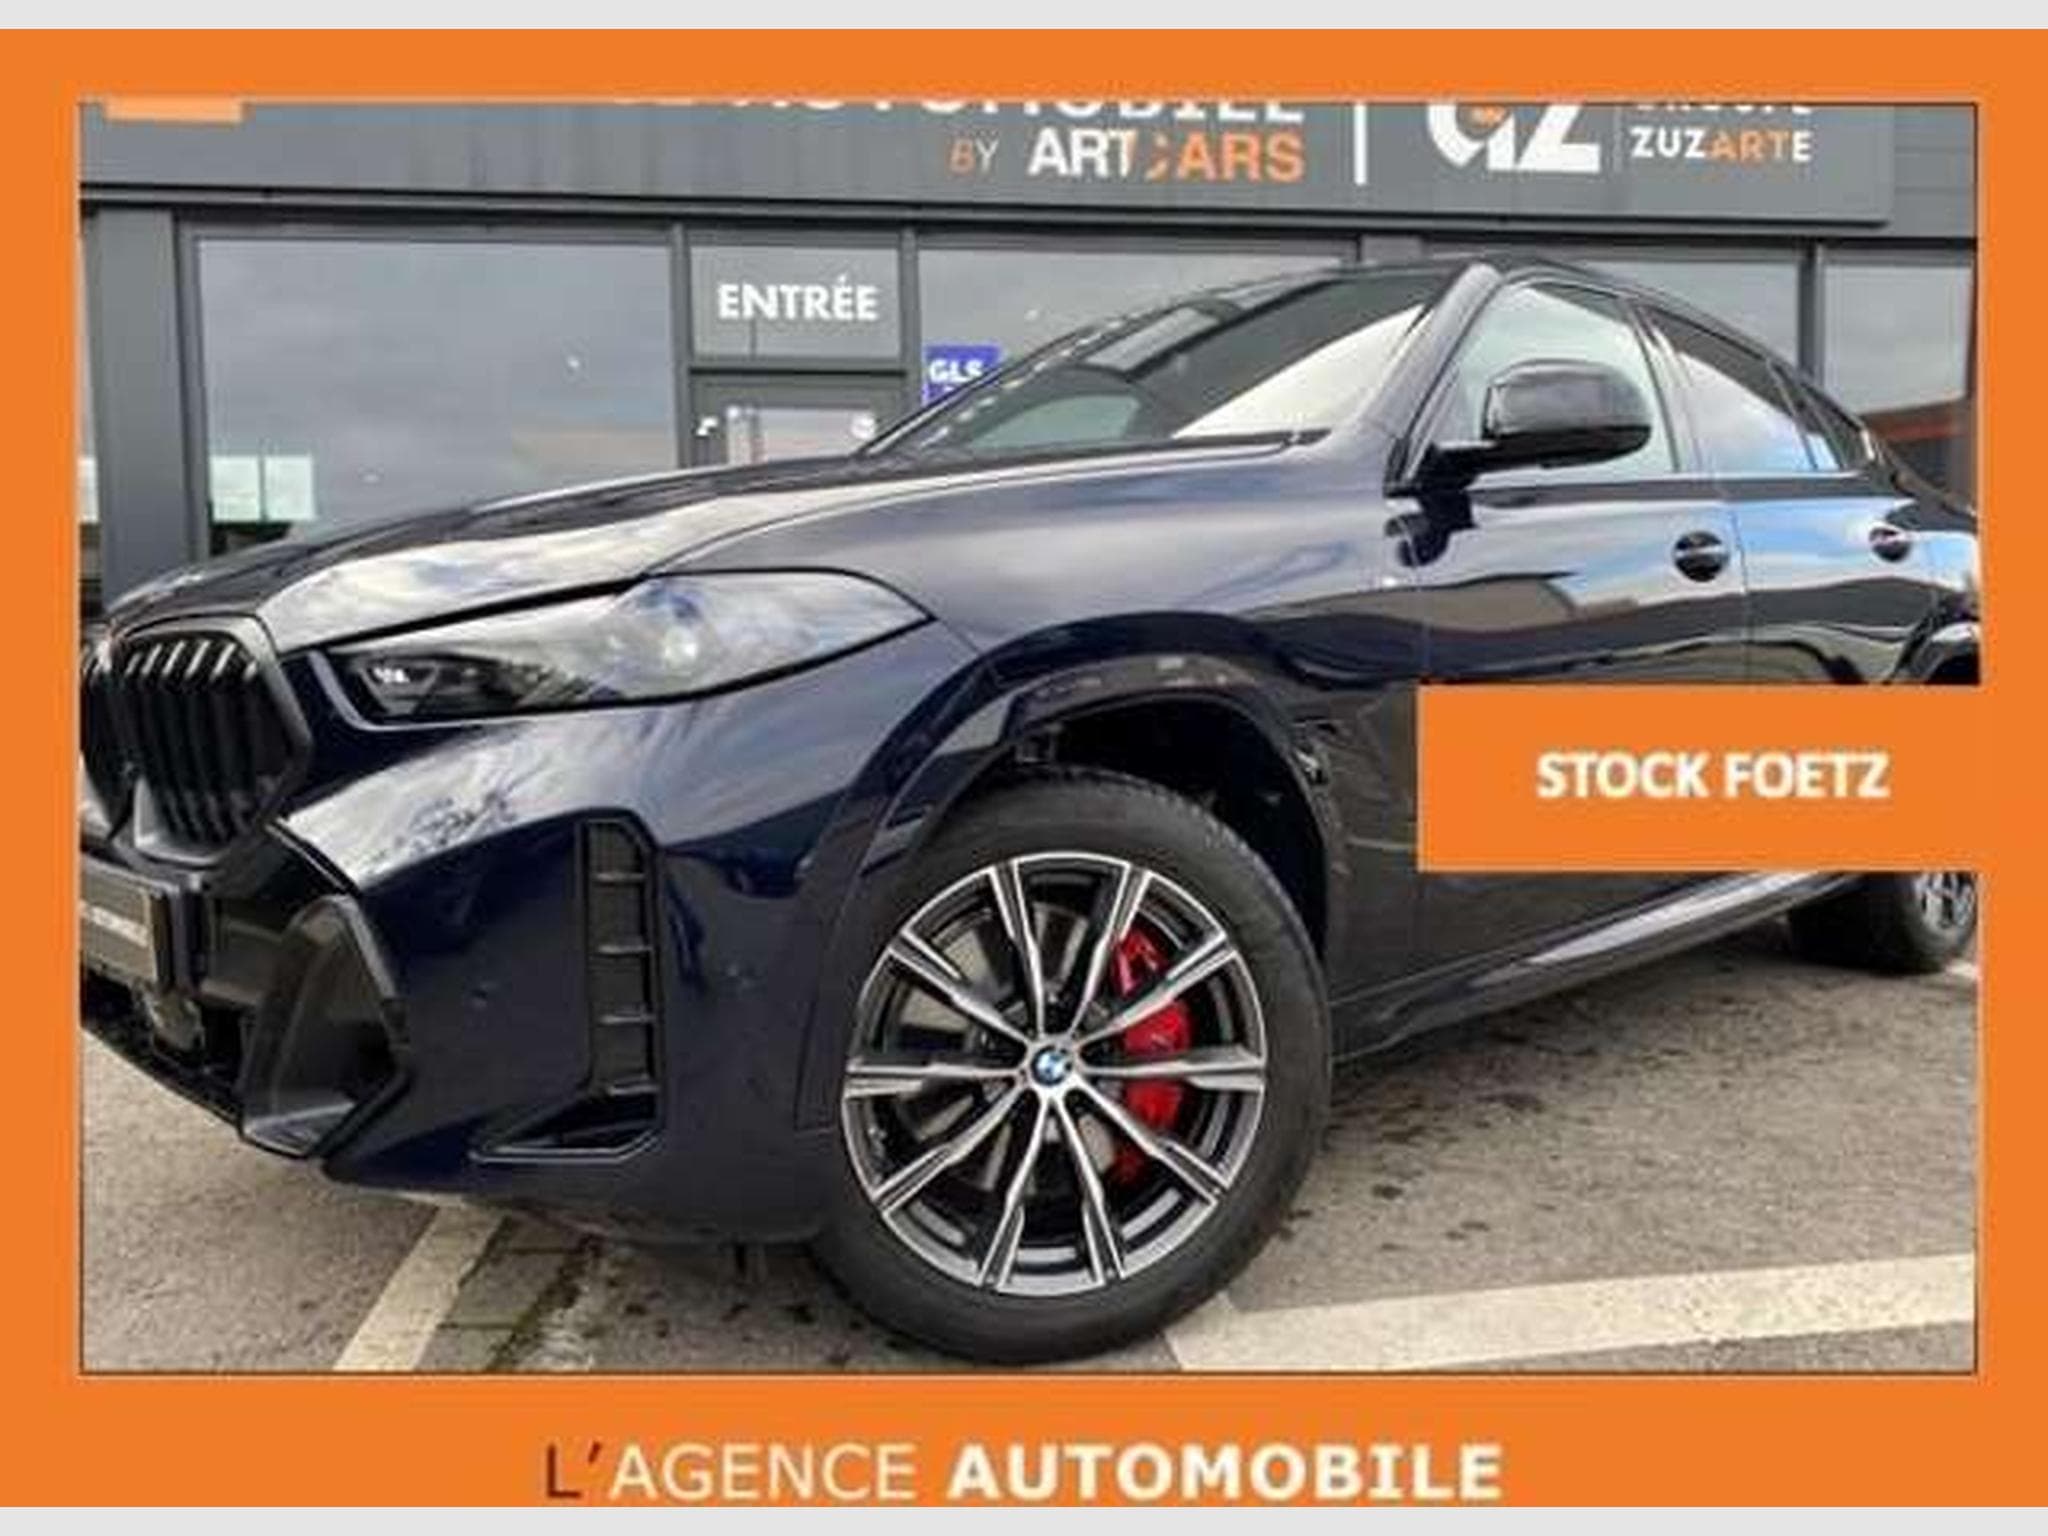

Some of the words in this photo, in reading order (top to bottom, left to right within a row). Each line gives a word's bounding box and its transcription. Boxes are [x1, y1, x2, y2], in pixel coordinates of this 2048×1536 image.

[950, 135, 998, 173] BY
[1630, 124, 1813, 162] ZUZARTE
[717, 272, 880, 321] ENTRÉE
[928, 358, 984, 384] GLS
